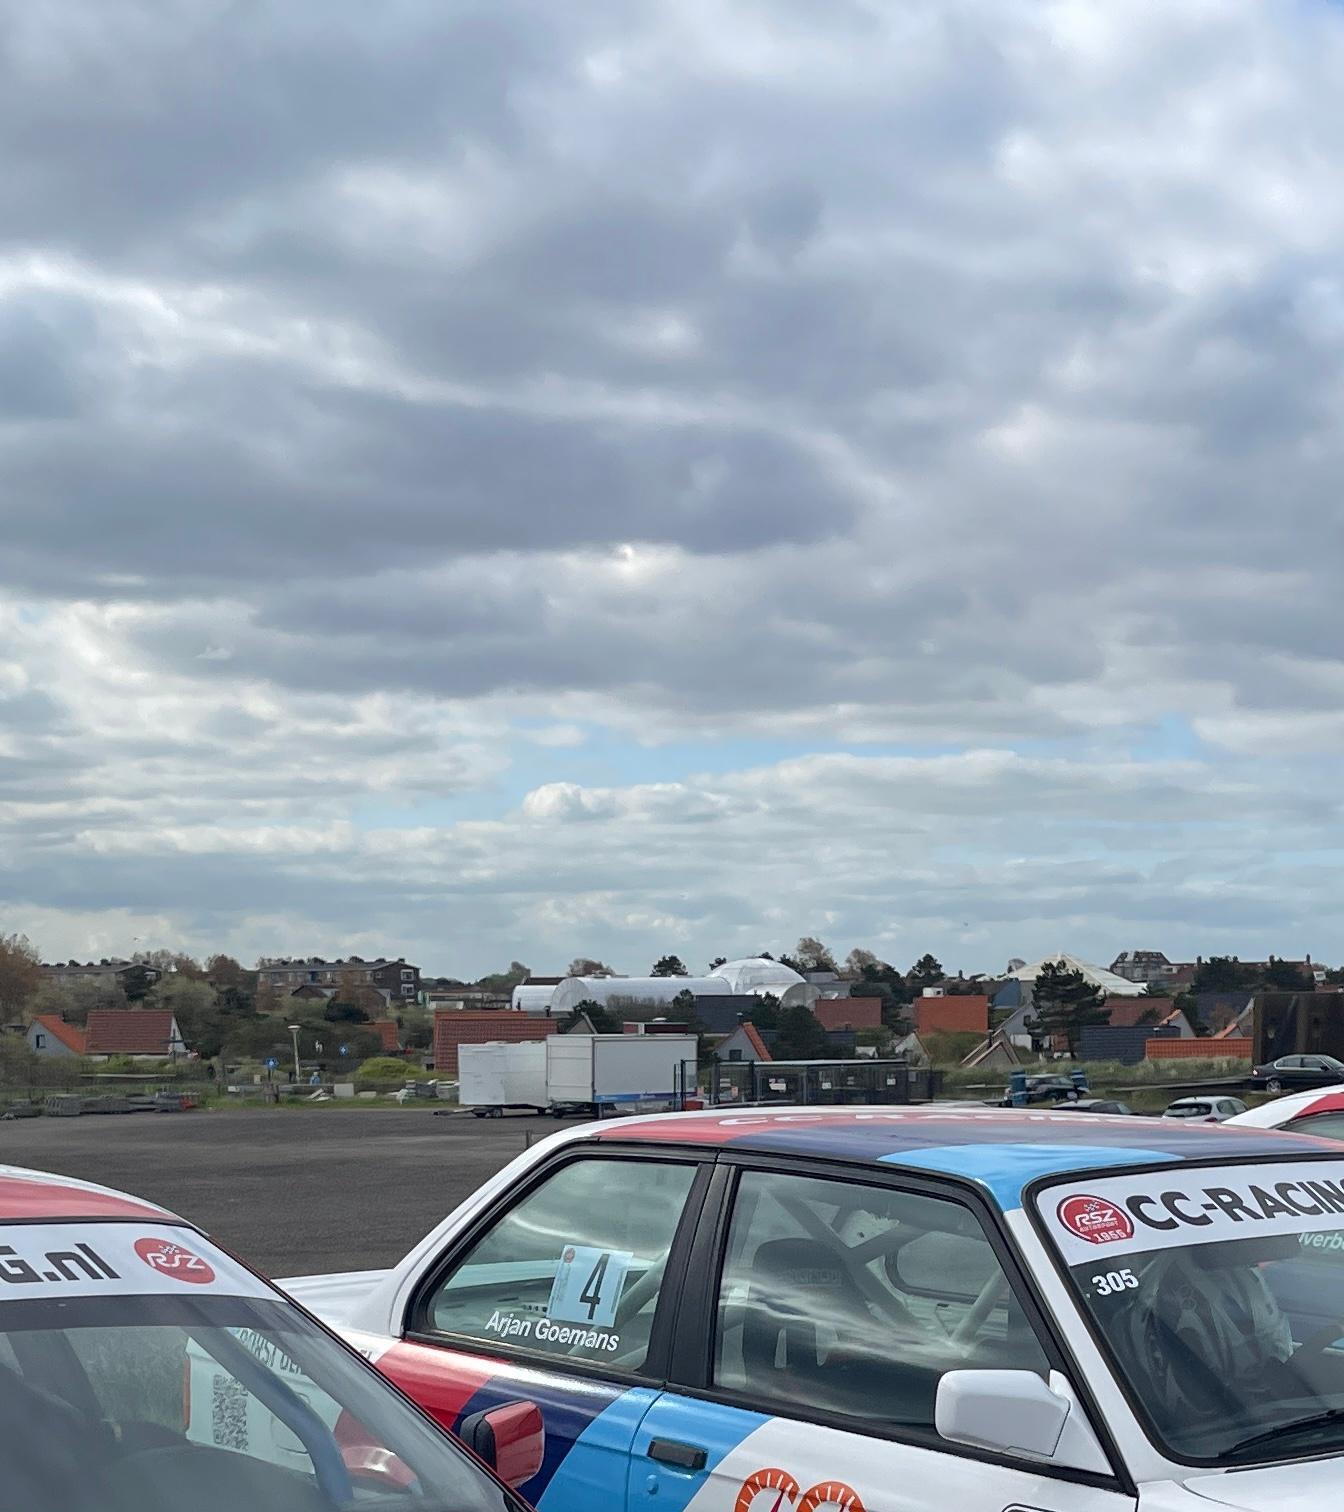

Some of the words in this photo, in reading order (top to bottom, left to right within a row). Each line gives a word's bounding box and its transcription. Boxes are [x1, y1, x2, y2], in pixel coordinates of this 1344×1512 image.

[1075, 1208, 1117, 1227] RSZ
[146, 1252, 206, 1272] RSZ
[579, 1253, 611, 1320] 4
[1091, 1268, 1140, 1296] 305
[484, 1310, 532, 1338] Arjan
[535, 1317, 621, 1352] Goemans
